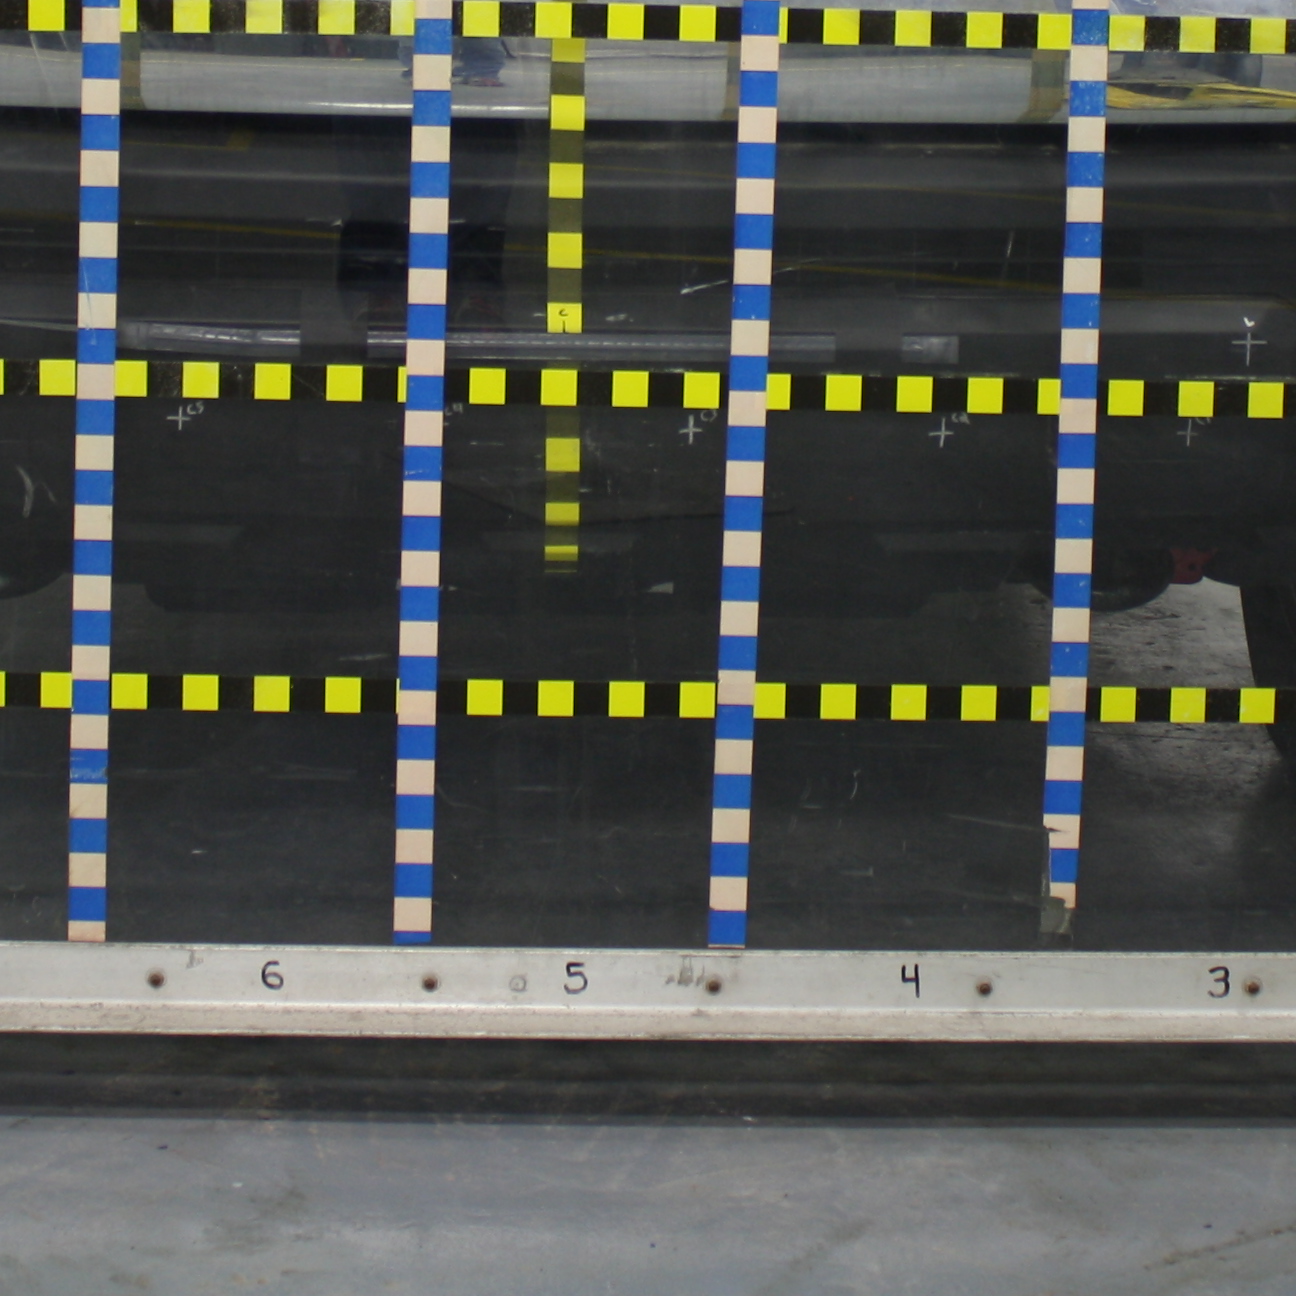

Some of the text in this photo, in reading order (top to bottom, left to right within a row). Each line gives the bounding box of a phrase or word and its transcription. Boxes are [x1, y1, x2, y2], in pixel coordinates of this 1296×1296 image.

[260, 961, 285, 991] 6
[563, 962, 589, 995] 5
[900, 963, 921, 999] 4
[1207, 966, 1232, 999] 3
